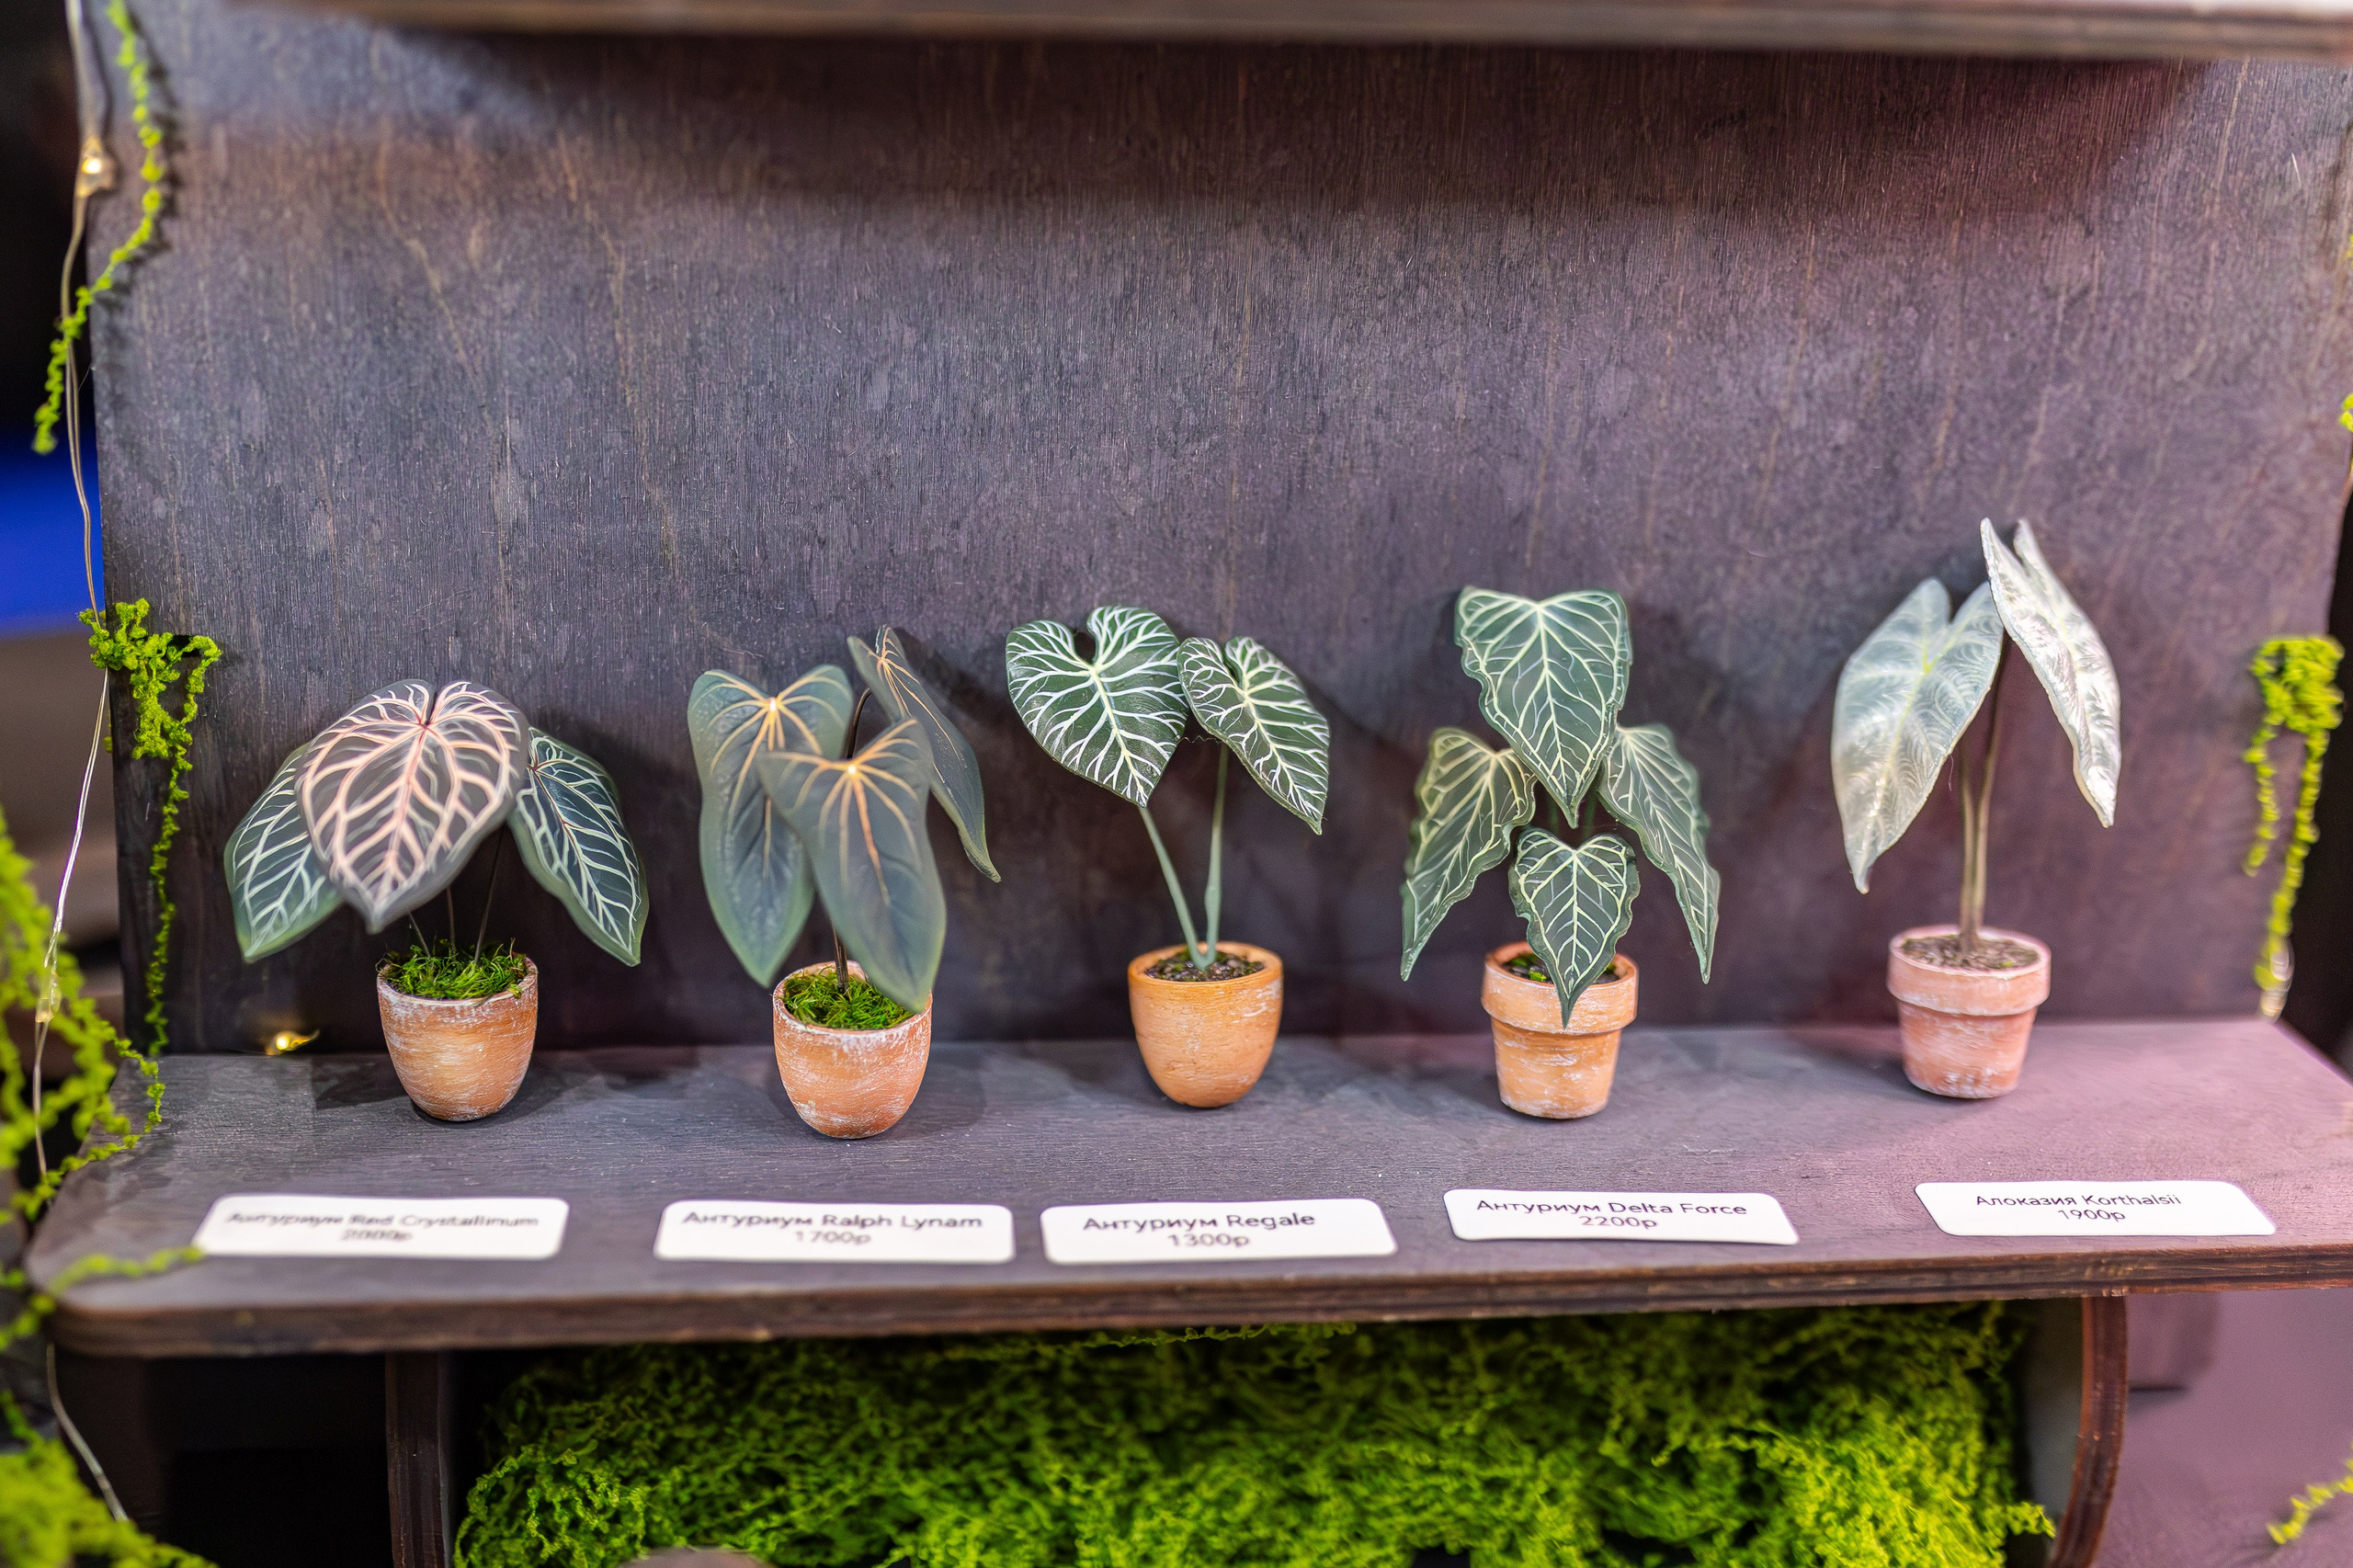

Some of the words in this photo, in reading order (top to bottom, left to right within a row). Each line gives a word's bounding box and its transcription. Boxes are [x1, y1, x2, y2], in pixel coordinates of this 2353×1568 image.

[1476, 1199, 1601, 1215] Антуриум
[1608, 1201, 1673, 1215] Delta
[1681, 1202, 1747, 1216] Force
[1976, 1195, 2077, 1207] Алоказия
[2082, 1194, 2181, 1207] Korthalsii
[681, 1210, 813, 1229] Антуриум
[822, 1214, 892, 1229] Ralph
[901, 1215, 983, 1231] Lynam
[1083, 1216, 1219, 1233] Антуриум
[1227, 1211, 1315, 1231] Regale
[1581, 1215, 1658, 1231] 2200р
[2057, 1209, 2126, 1223] 1900р
[1167, 1233, 1251, 1249] 1300р
